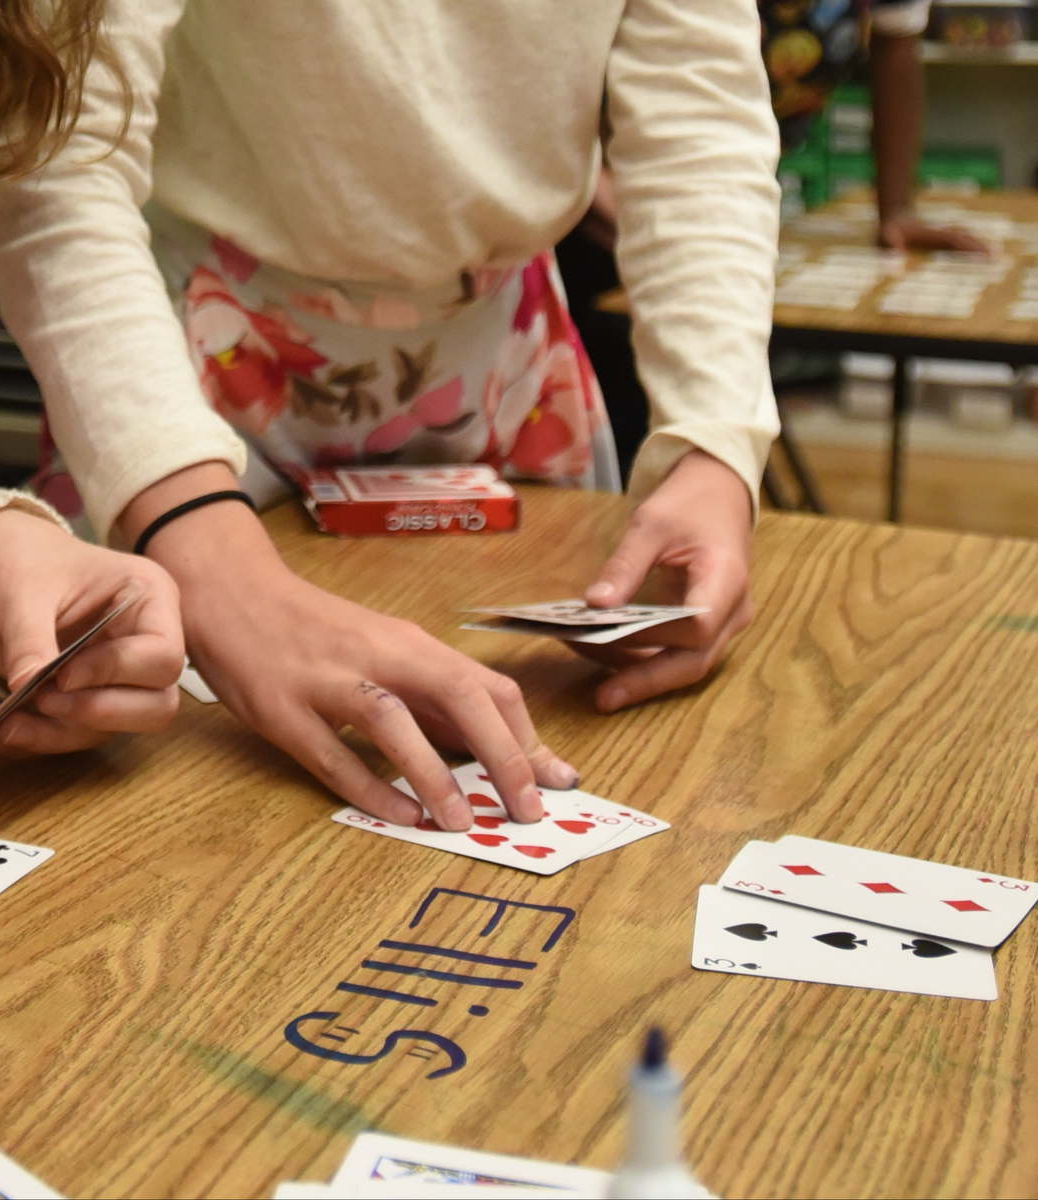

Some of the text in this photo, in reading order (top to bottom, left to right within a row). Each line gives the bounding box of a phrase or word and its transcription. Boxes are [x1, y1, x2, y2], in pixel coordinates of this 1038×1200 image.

[385, 513, 486, 531] CLASSIC
[734, 880, 765, 893] 3
[999, 880, 1030, 892] 3
[703, 957, 736, 969] 3
